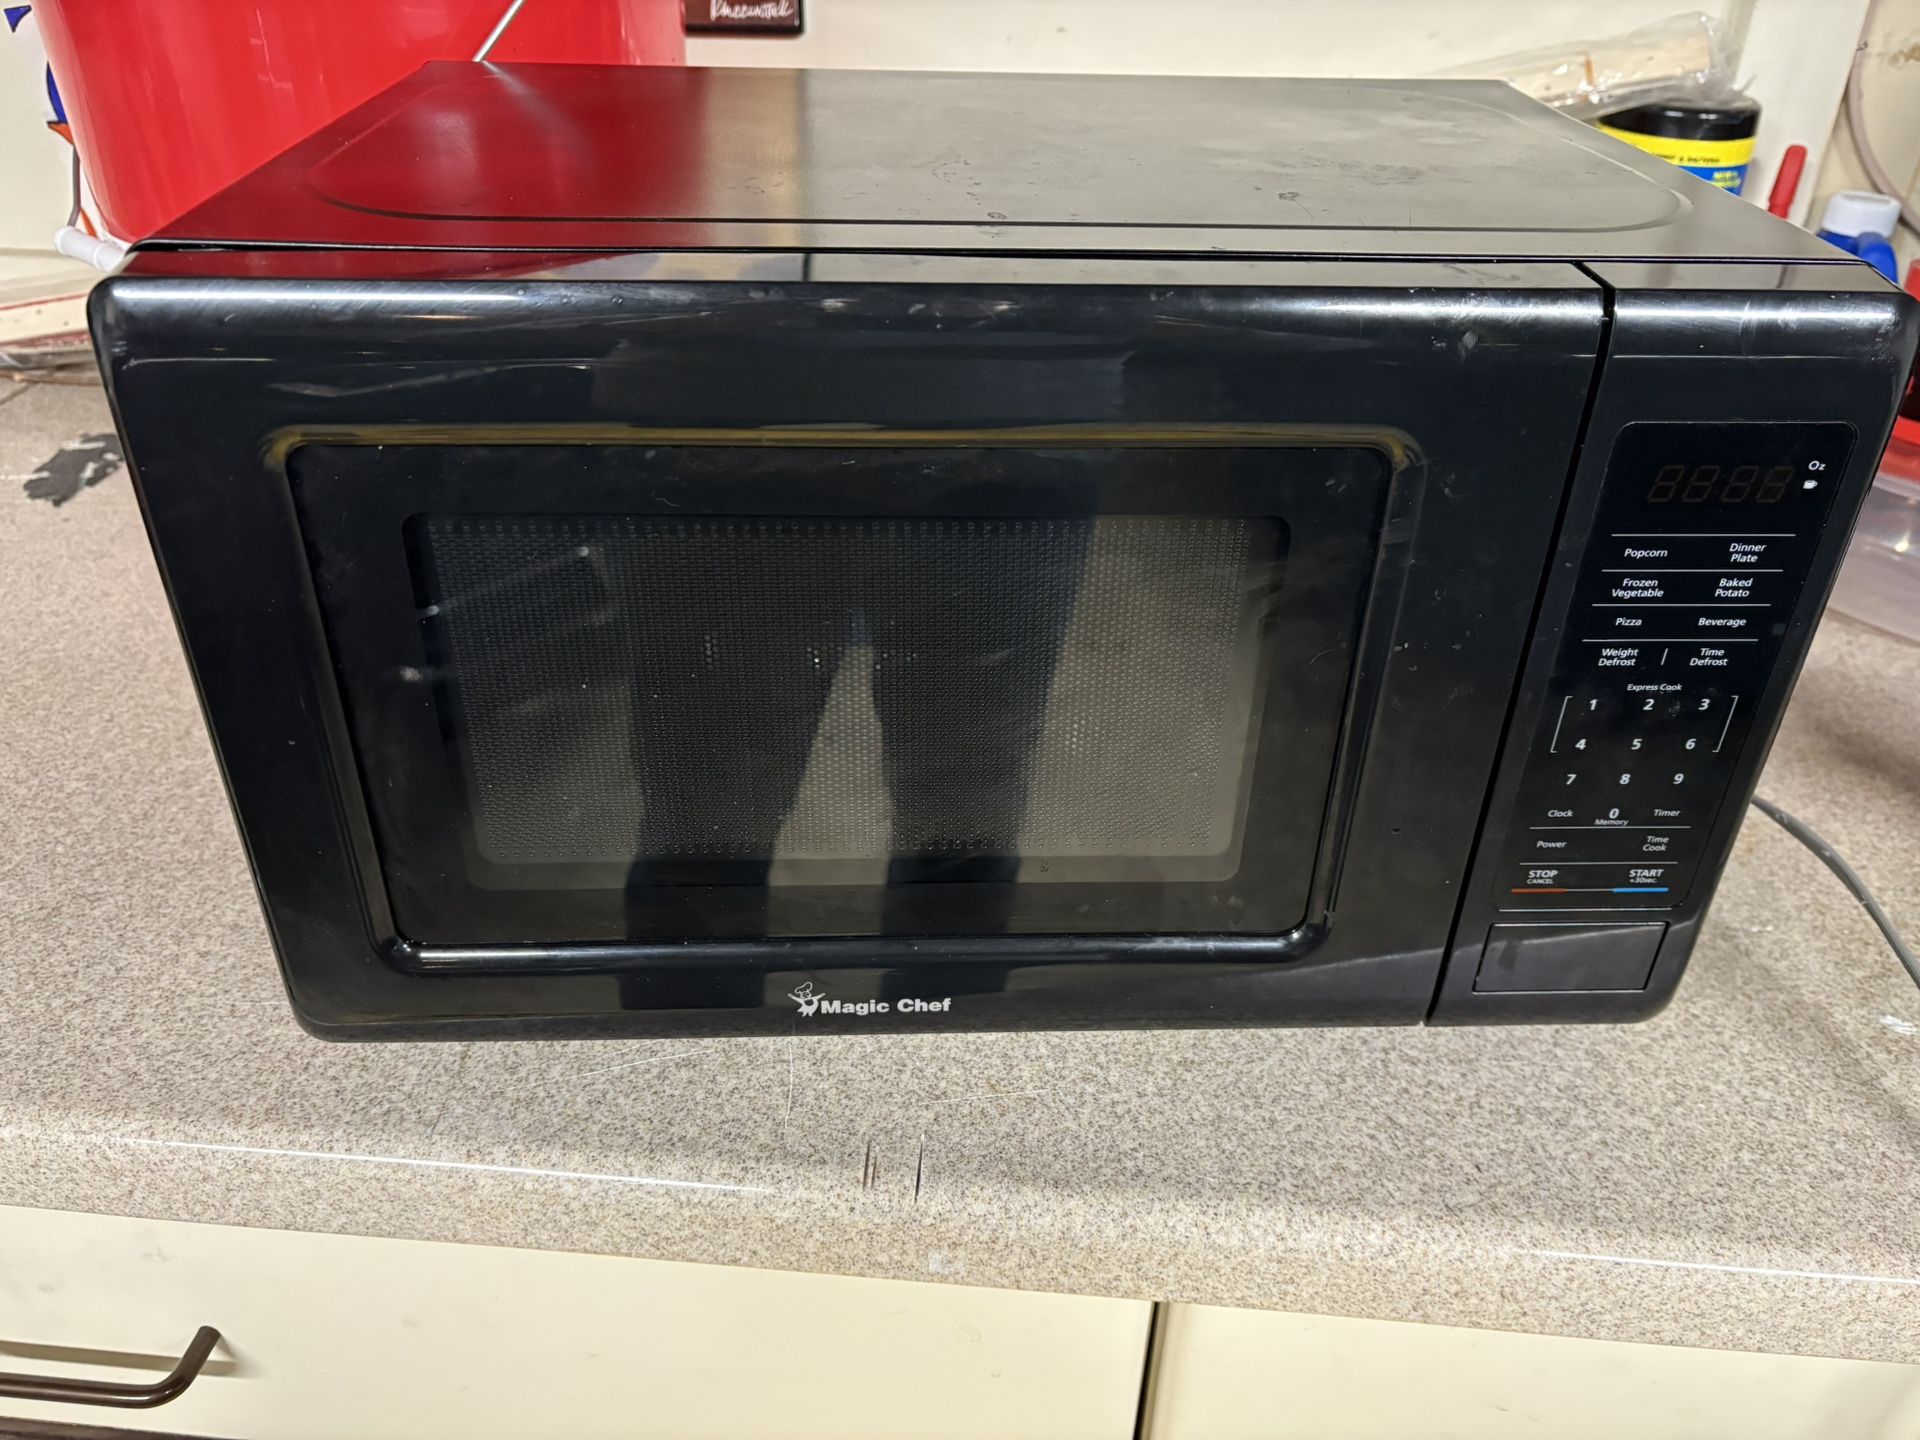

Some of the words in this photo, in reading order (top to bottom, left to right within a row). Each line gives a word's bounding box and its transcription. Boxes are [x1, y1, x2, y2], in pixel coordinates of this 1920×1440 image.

[1808, 460, 1826, 471] Oz
[1729, 542, 1767, 552] Dinner
[1623, 548, 1668, 560] Popcorn
[1730, 553, 1759, 563] Plate
[1622, 577, 1659, 588] Frozen
[1718, 577, 1754, 587] Baked
[1611, 587, 1665, 600] Vegetable
[1714, 588, 1750, 598] Potato
[1615, 617, 1643, 626] Pizza
[1697, 617, 1747, 628] Beverage
[1601, 647, 1639, 659] Weight
[1700, 647, 1725, 657] Time
[1597, 656, 1637, 667] Defrost
[1689, 656, 1729, 666] Defrost
[1626, 683, 1659, 693] Express
[1658, 683, 1683, 691] Cook
[1589, 698, 1598, 711] 1
[1642, 698, 1655, 711] 2
[1698, 698, 1711, 711] 3
[1575, 738, 1587, 750] 4
[1631, 738, 1643, 750] 5
[1685, 738, 1697, 750] 6
[1565, 773, 1577, 785] 7
[1619, 773, 1631, 785] 8
[1673, 773, 1685, 785] 9
[1547, 809, 1574, 818] Clock
[1608, 807, 1620, 819] 0
[1653, 808, 1681, 817] Timer
[1594, 818, 1629, 826] Memory
[1536, 840, 1567, 849] Power
[1645, 835, 1670, 844] Time
[1642, 843, 1667, 852] Cook
[1527, 869, 1559, 879] STOP
[1628, 868, 1665, 879] START
[821, 1000, 889, 1015] Magic
[897, 998, 951, 1012] Chef
